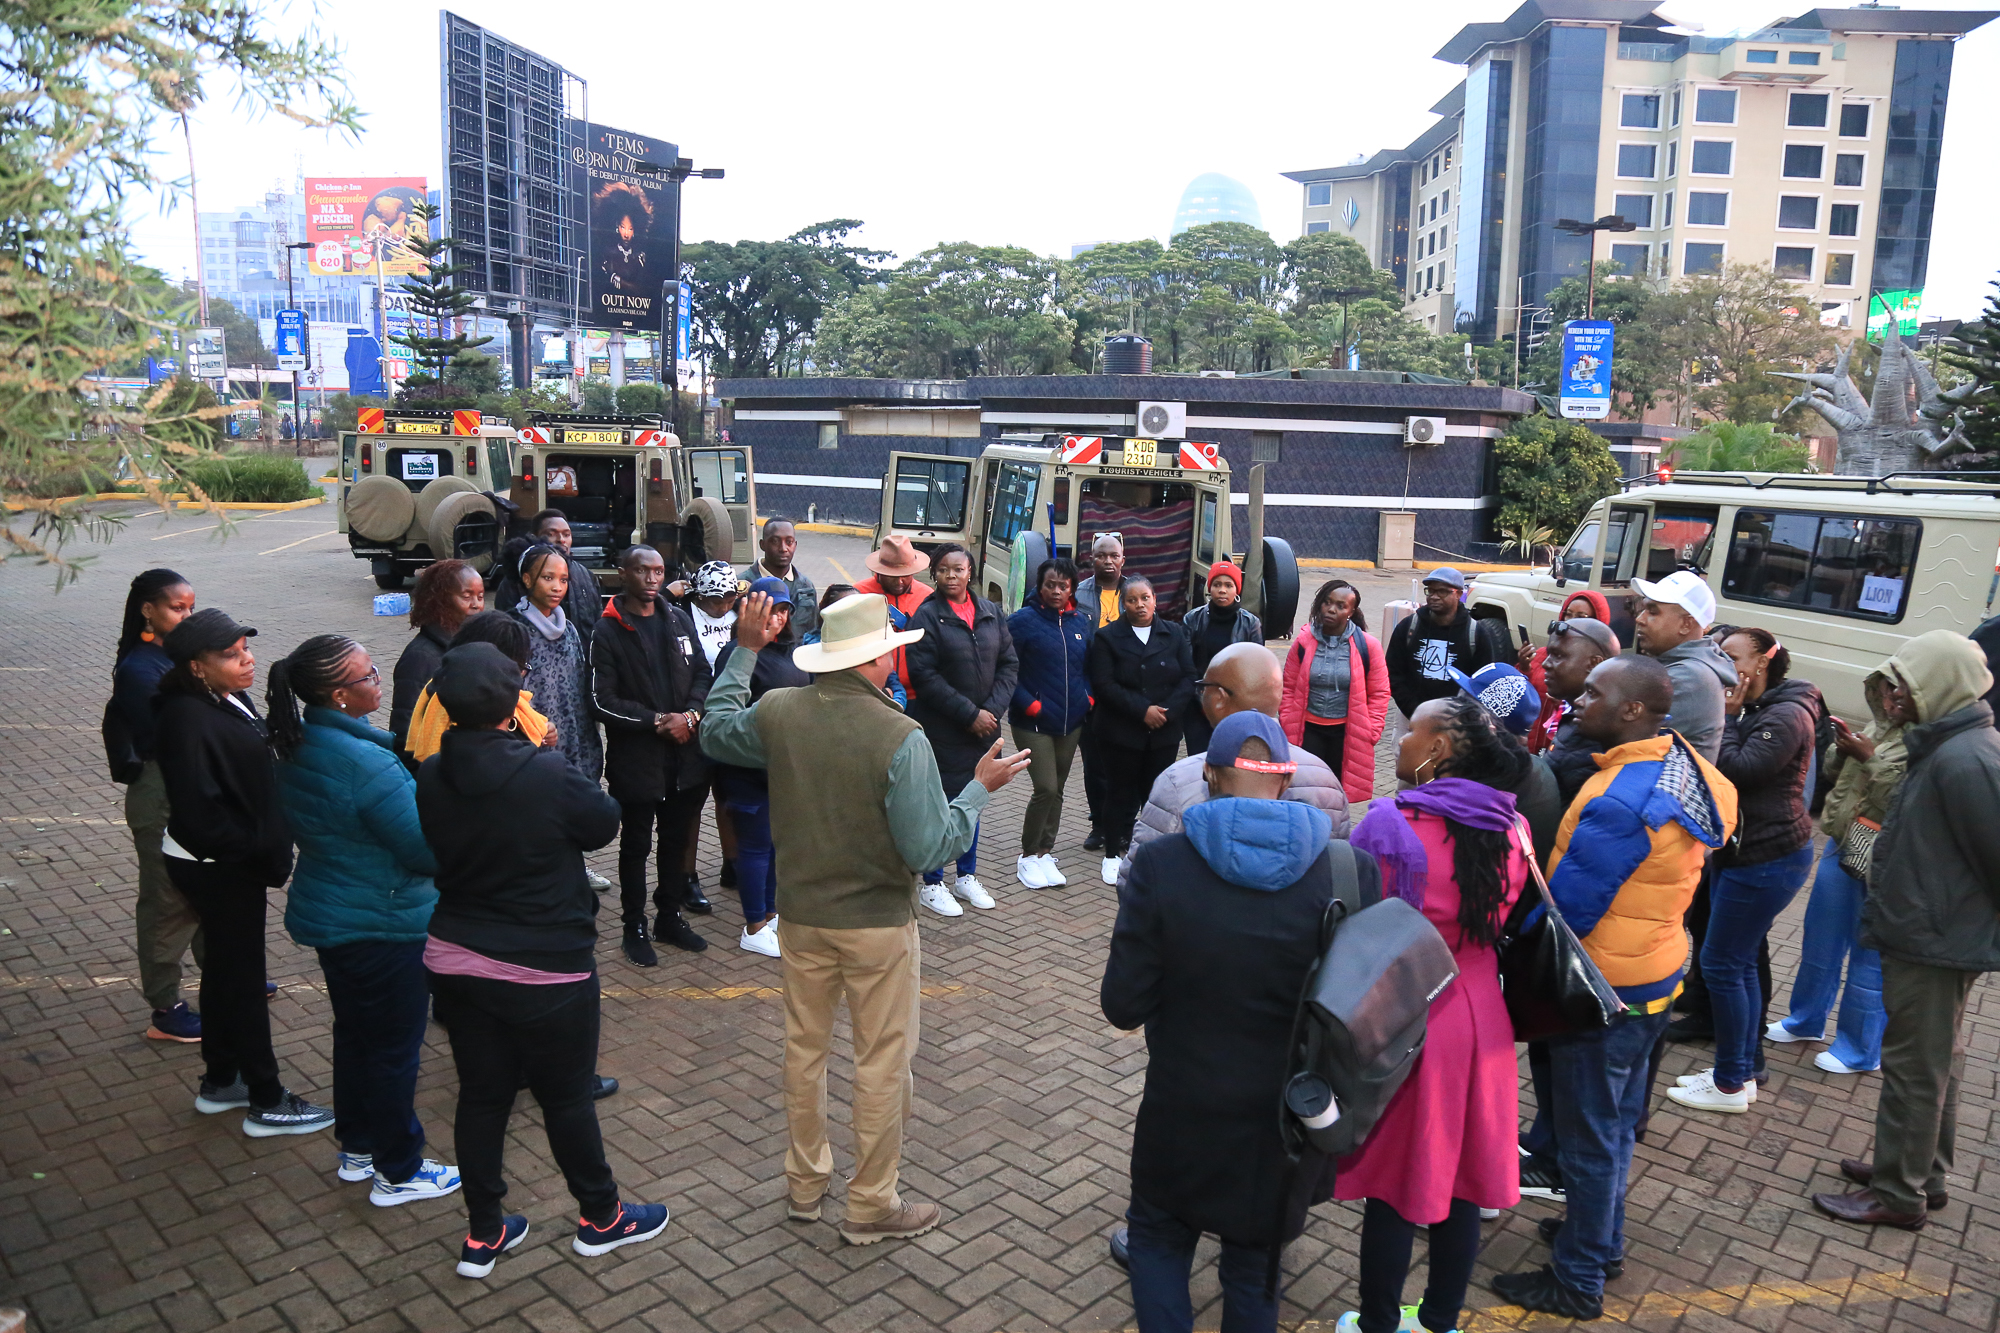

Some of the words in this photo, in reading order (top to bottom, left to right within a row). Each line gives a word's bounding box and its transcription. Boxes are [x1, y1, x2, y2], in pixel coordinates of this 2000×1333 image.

[606, 132, 645, 156] TEMS
[612, 156, 623, 172] IN
[600, 171, 619, 182] DEBUT
[620, 175, 642, 187] STUDIO
[643, 180, 662, 191] ALBUM
[310, 194, 369, 206] Changamka
[321, 204, 336, 214] NA
[337, 204, 345, 214] 3
[312, 214, 354, 224] PIECER!
[321, 258, 340, 267] 620
[602, 294, 625, 307] OUT
[627, 296, 652, 310] NOW
[403, 424, 418, 433] KCW
[567, 433, 588, 442] KCP
[594, 433, 619, 442] 180V
[1134, 441, 1154, 452] KDG
[1127, 454, 1153, 465] 231Q
[1103, 467, 1139, 475] TOURIST
[1143, 469, 1179, 477] VEHICLE
[1865, 587, 1893, 603] LION
